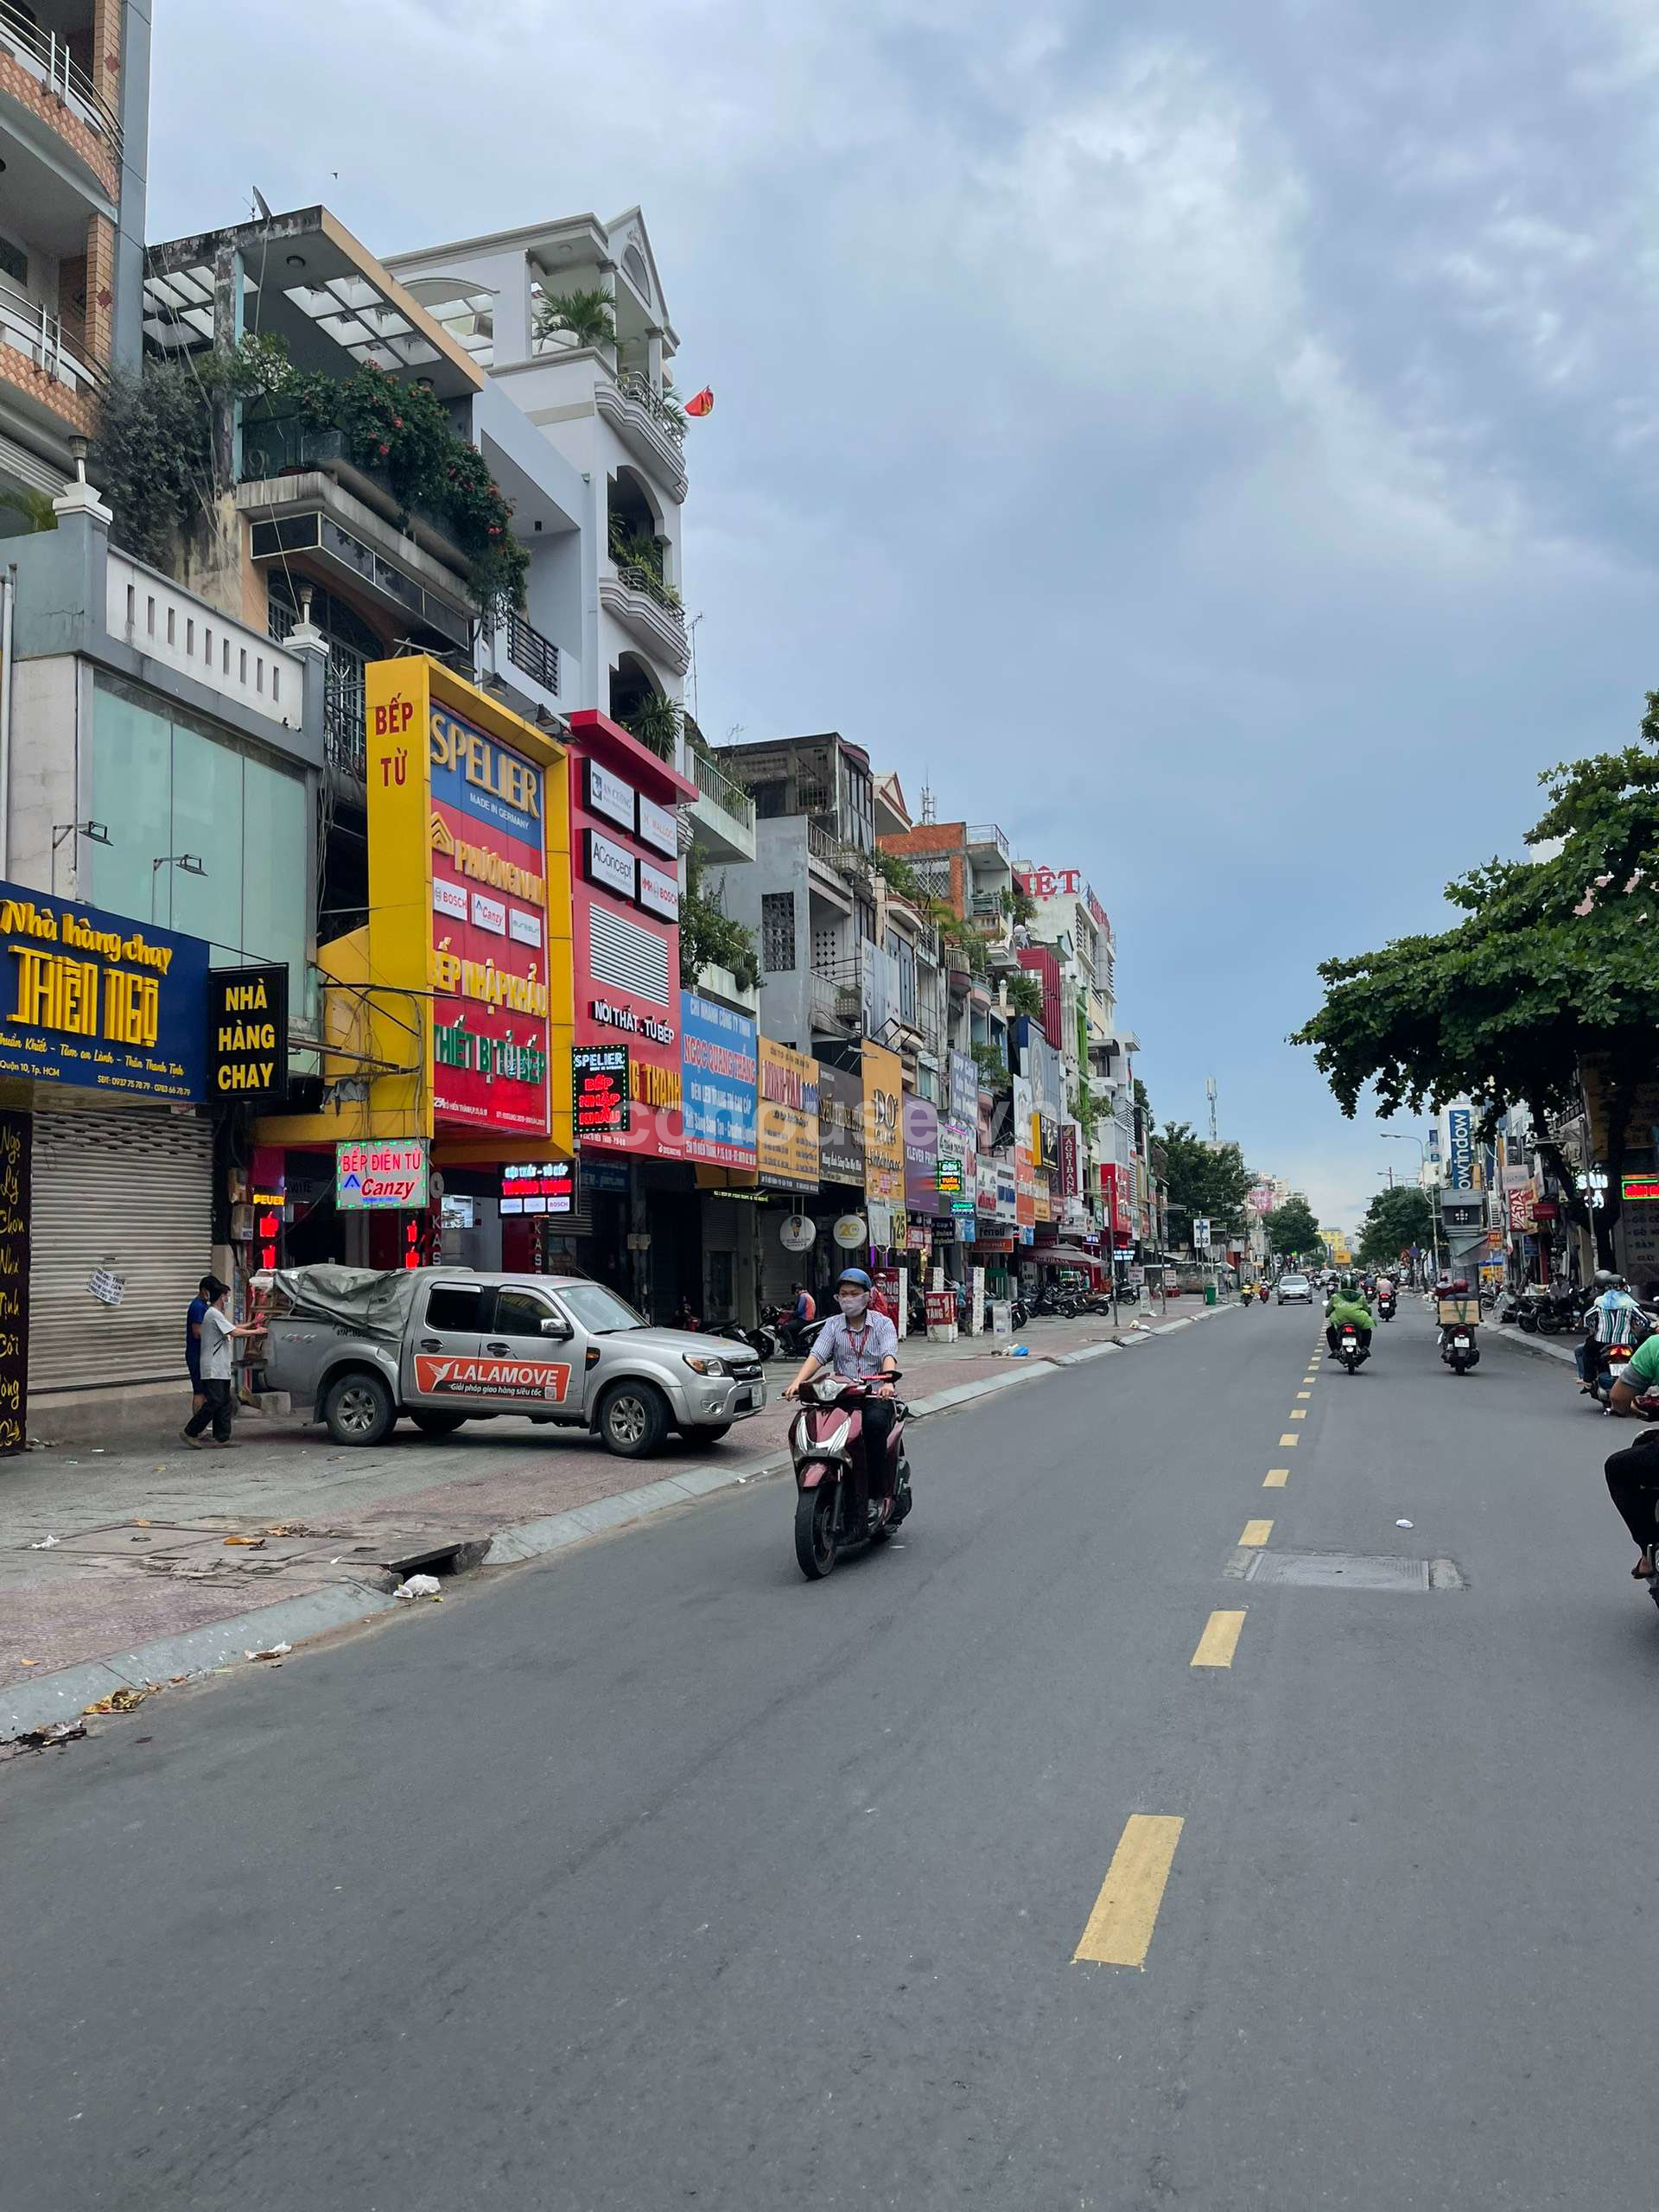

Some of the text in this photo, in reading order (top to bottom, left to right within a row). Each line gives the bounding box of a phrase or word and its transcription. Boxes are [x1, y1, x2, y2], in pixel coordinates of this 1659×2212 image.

[375, 693, 413, 735] BẾP
[380, 747, 408, 787] TỪ
[429, 714, 539, 819] SPELIER
[469, 792, 530, 830] MADE IN GERMANY
[593, 842, 632, 880] AConcept
[442, 891, 467, 909] BOSCH
[0, 899, 172, 976] Nhà hàng chay
[225, 978, 268, 1012] NHÀ
[427, 937, 549, 1019] BẾP NHẬP KHẨU
[218, 1020, 276, 1052] HÀNG
[594, 999, 613, 1027] NỘI
[613, 1005, 639, 1033] THẤT
[658, 1019, 675, 1045] BẾP
[435, 1014, 475, 1070] THIẾT
[476, 1035, 493, 1084] BỊ
[574, 1052, 625, 1068] SPELIER
[218, 1063, 276, 1090] CHAY
[342, 1147, 368, 1173] BẾP
[371, 1148, 401, 1175] ĐIỆN
[1064, 1137, 1075, 1196] AGRIBANK
[1452, 1113, 1471, 1190] owindow
[361, 1178, 416, 1199] Canzy
[453, 1364, 559, 1386] LALAMOVE
